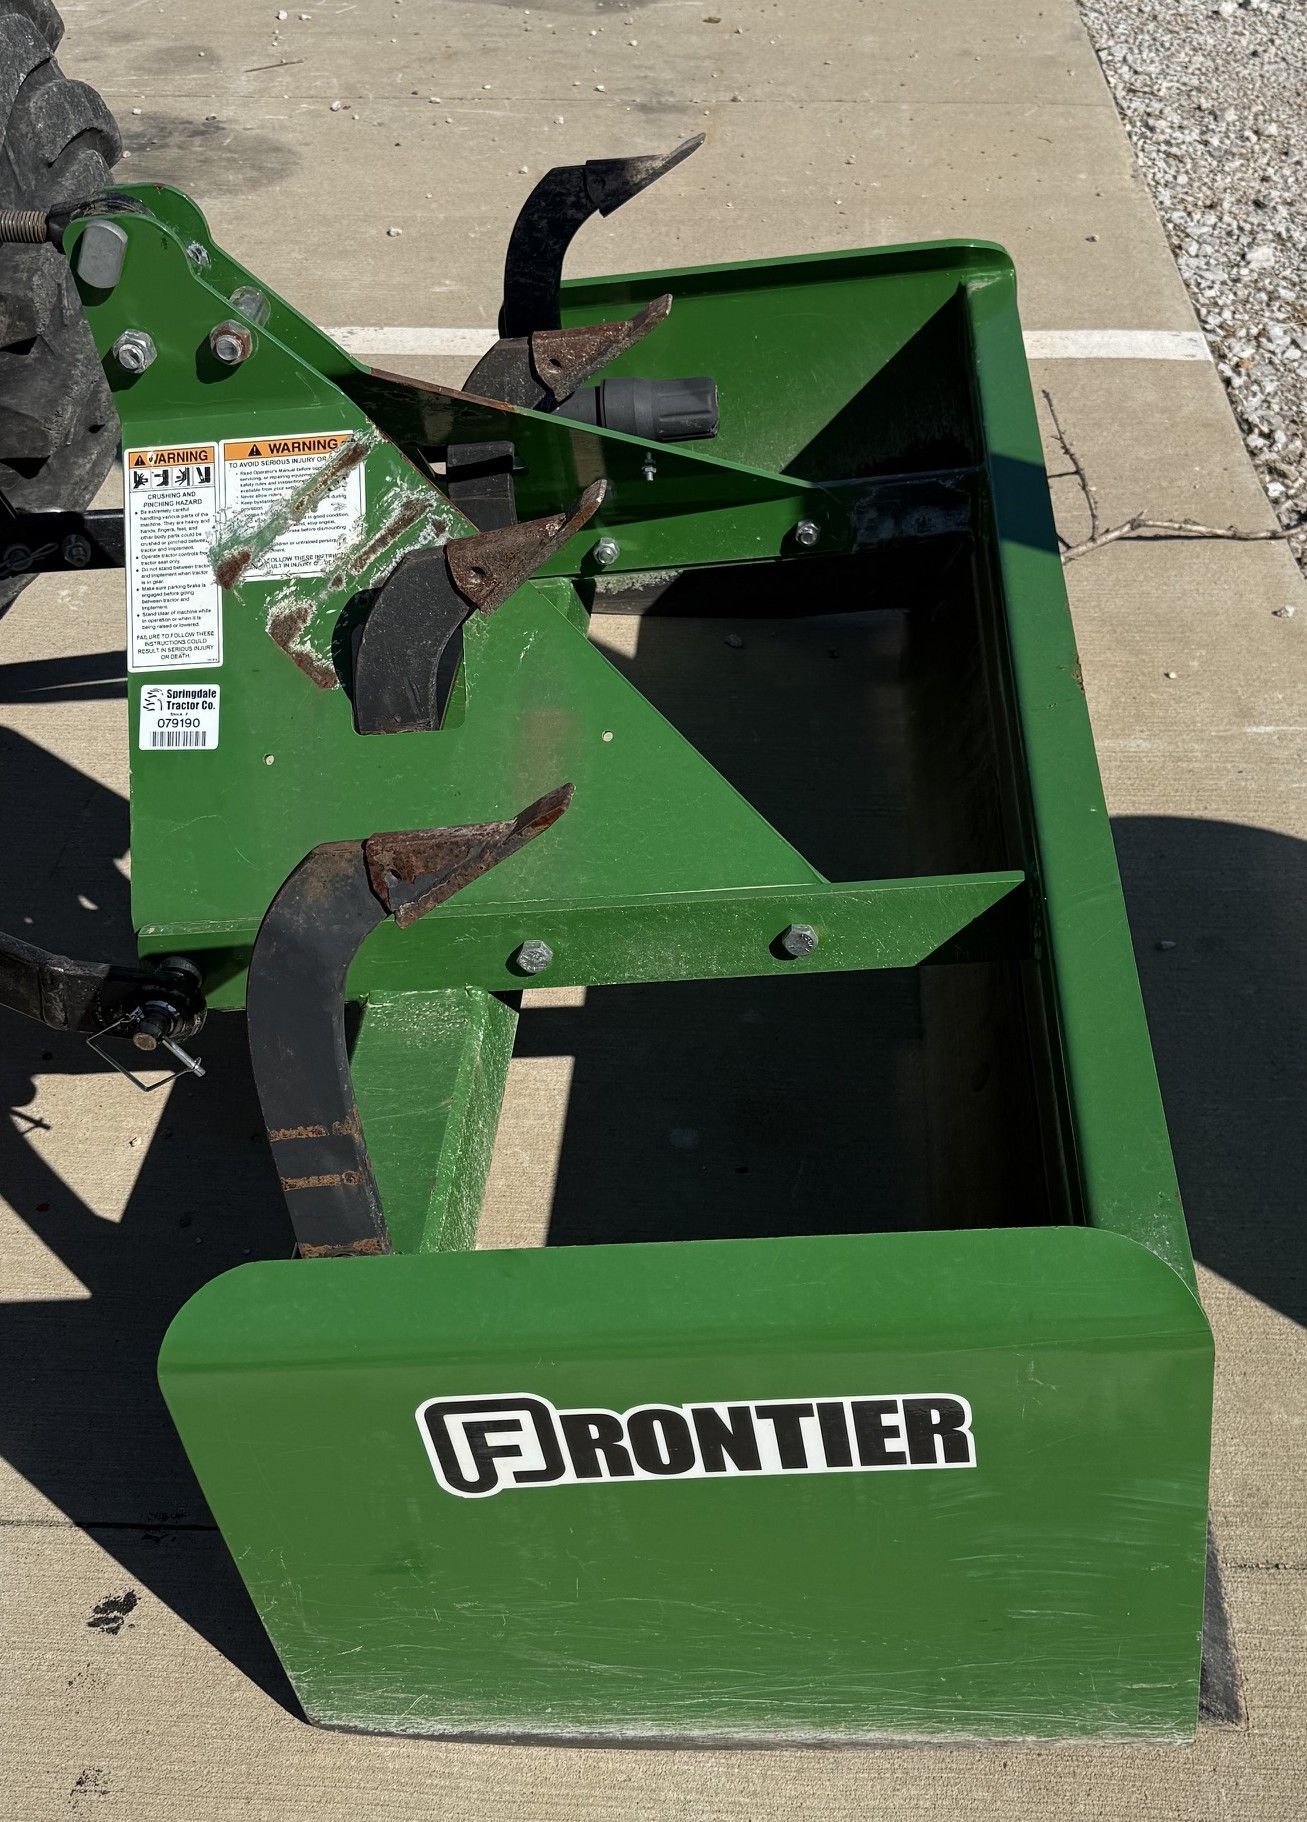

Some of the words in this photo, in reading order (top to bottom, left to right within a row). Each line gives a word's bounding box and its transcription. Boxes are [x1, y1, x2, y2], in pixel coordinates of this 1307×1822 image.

[268, 438, 338, 454] WARNING
[167, 688, 216, 699] Springdale
[166, 700, 199, 710] Tractor
[202, 700, 215, 710] Co.
[157, 718, 200, 728] 079190
[420, 1395, 971, 1495] FRONTIER
